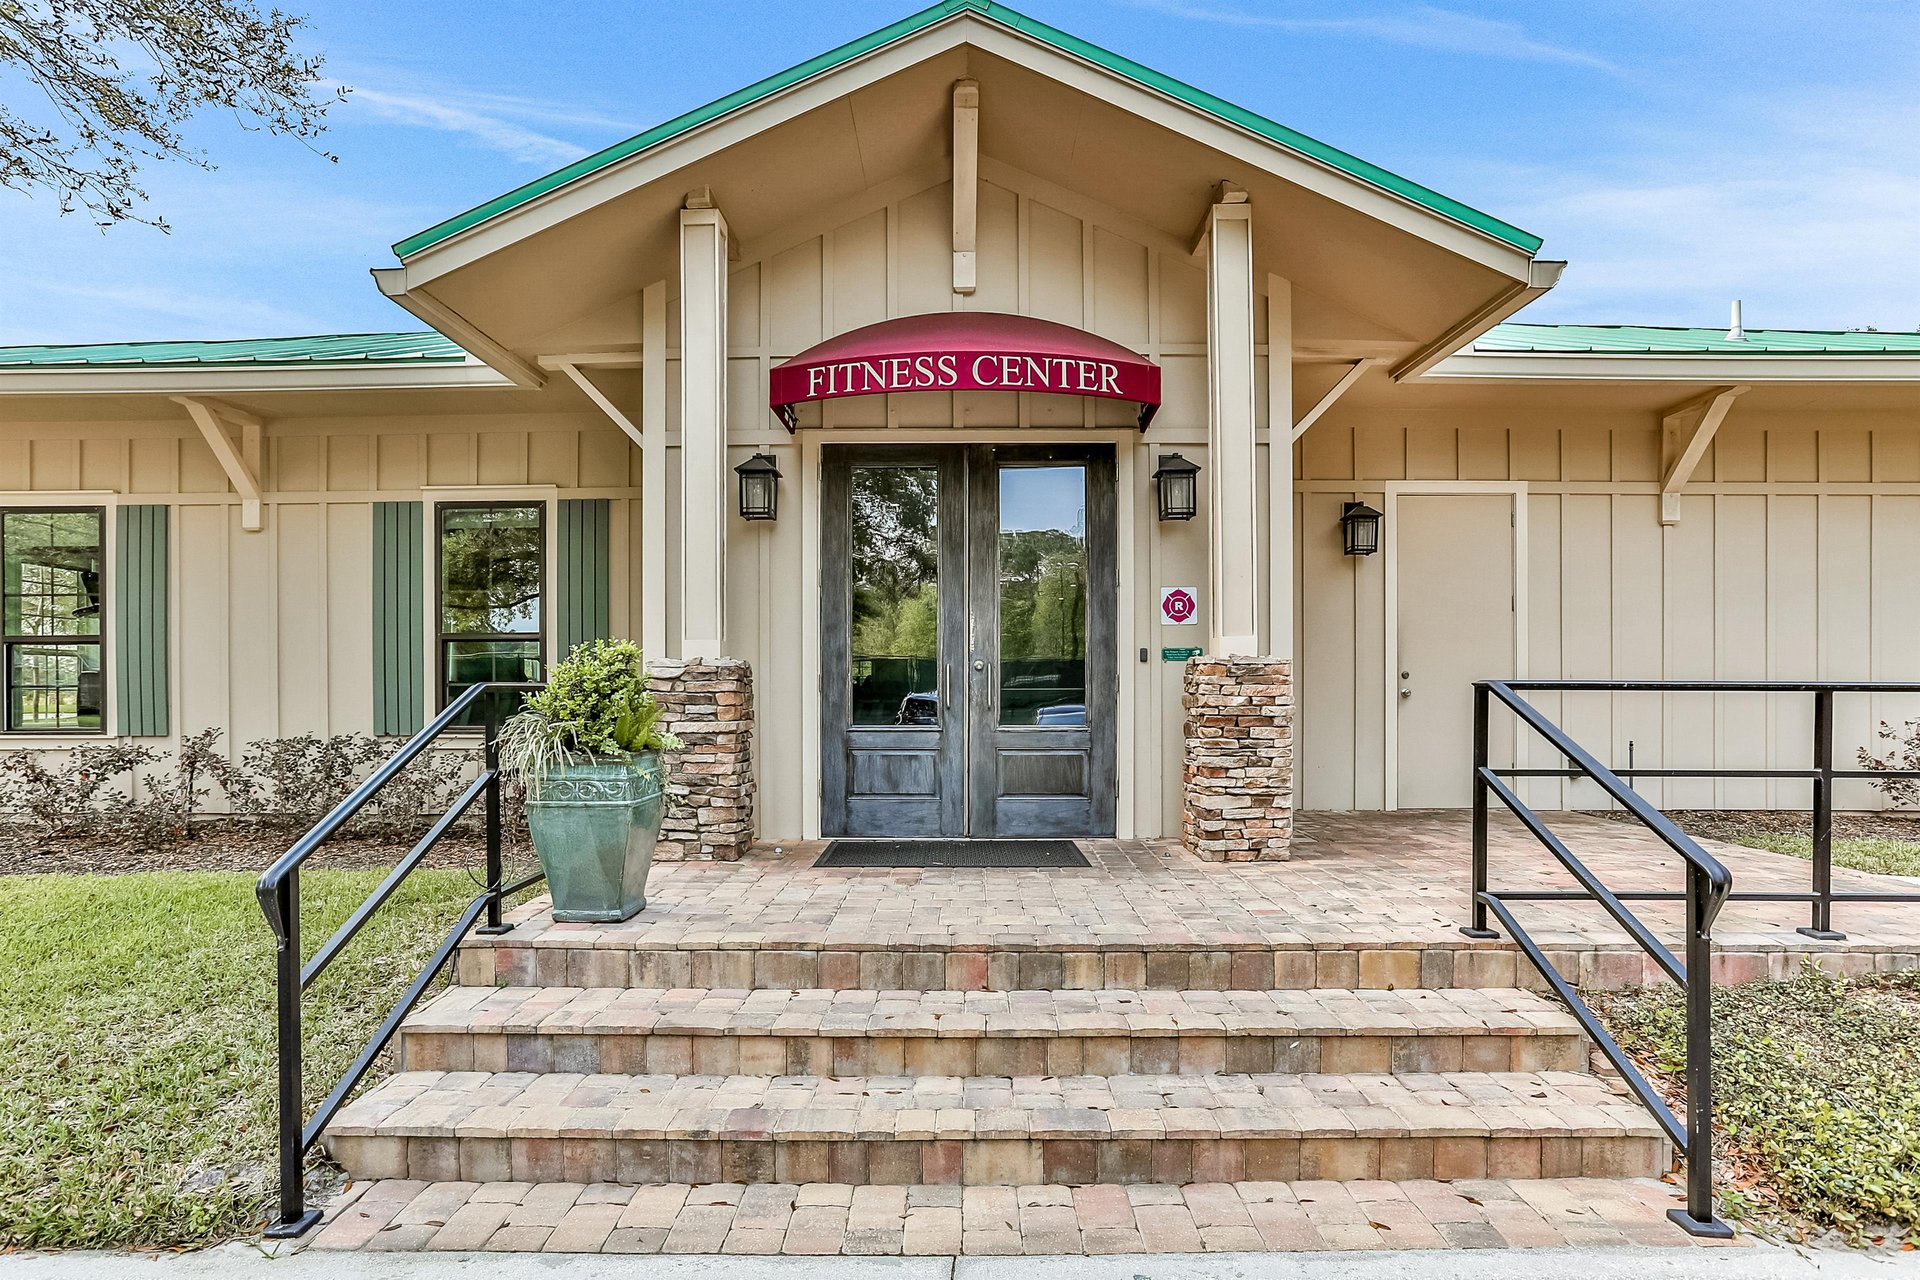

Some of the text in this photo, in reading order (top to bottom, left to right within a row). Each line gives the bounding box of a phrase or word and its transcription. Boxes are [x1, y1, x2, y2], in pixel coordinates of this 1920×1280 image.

[806, 355, 1124, 397] FITNESS CENTER
[1174, 601, 1184, 611] R
